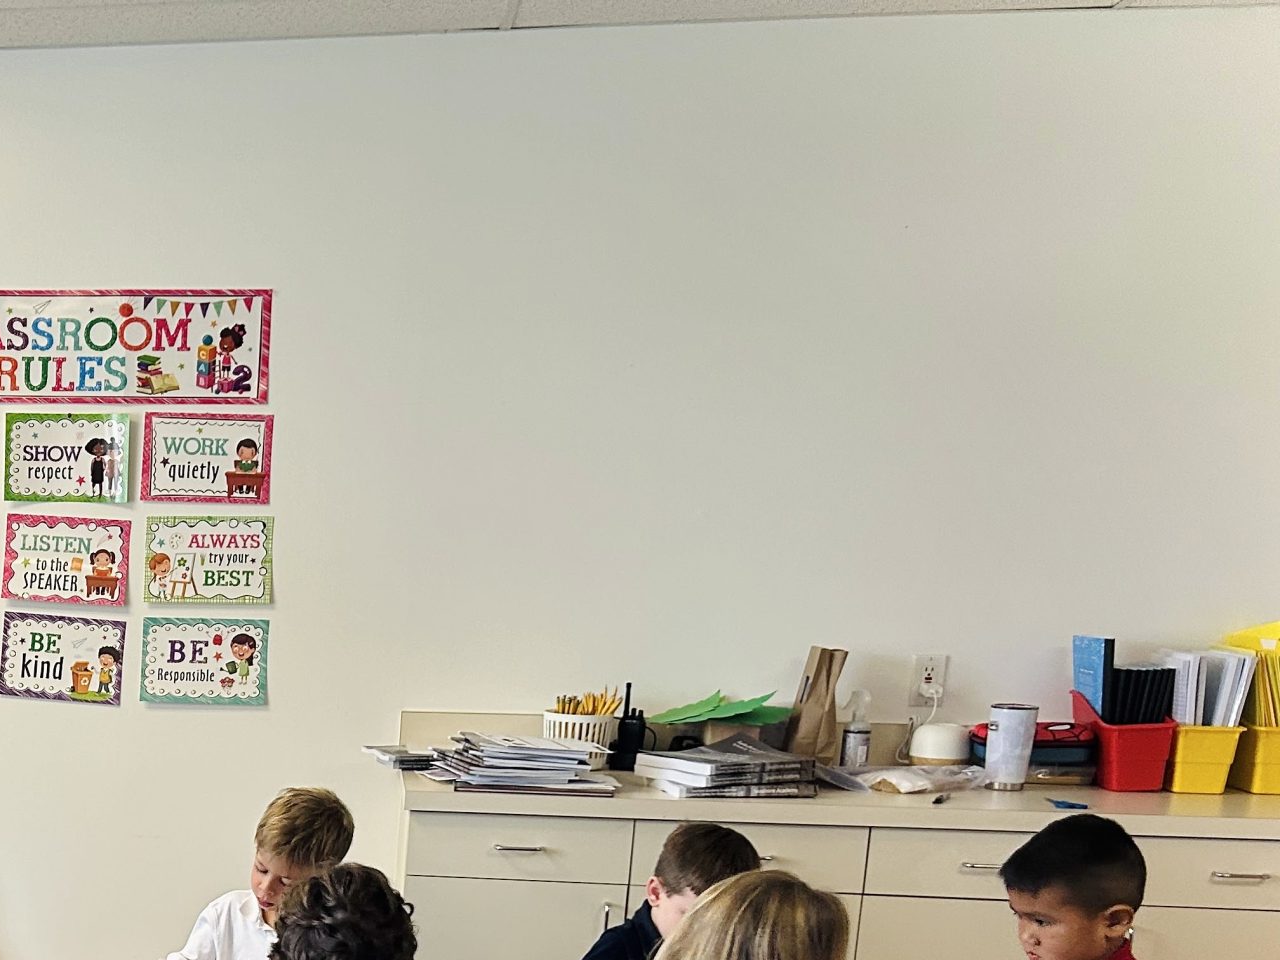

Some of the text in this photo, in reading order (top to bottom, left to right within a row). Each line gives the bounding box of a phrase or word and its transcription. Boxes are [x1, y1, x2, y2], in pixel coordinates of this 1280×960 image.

[23, 445, 83, 462] SHOW
[162, 436, 230, 456] WORK
[28, 465, 73, 483] respect
[168, 461, 220, 484] quietly
[21, 534, 92, 556] LISTEN
[187, 533, 261, 549] ALWAYS
[36, 557, 69, 573] to the
[209, 552, 250, 566] try your
[23, 571, 78, 592] SPEAKER
[203, 569, 254, 587] BEST
[28, 632, 62, 654] BE
[167, 639, 209, 664] BE
[21, 653, 64, 681] kind
[157, 667, 215, 684] Responsible
